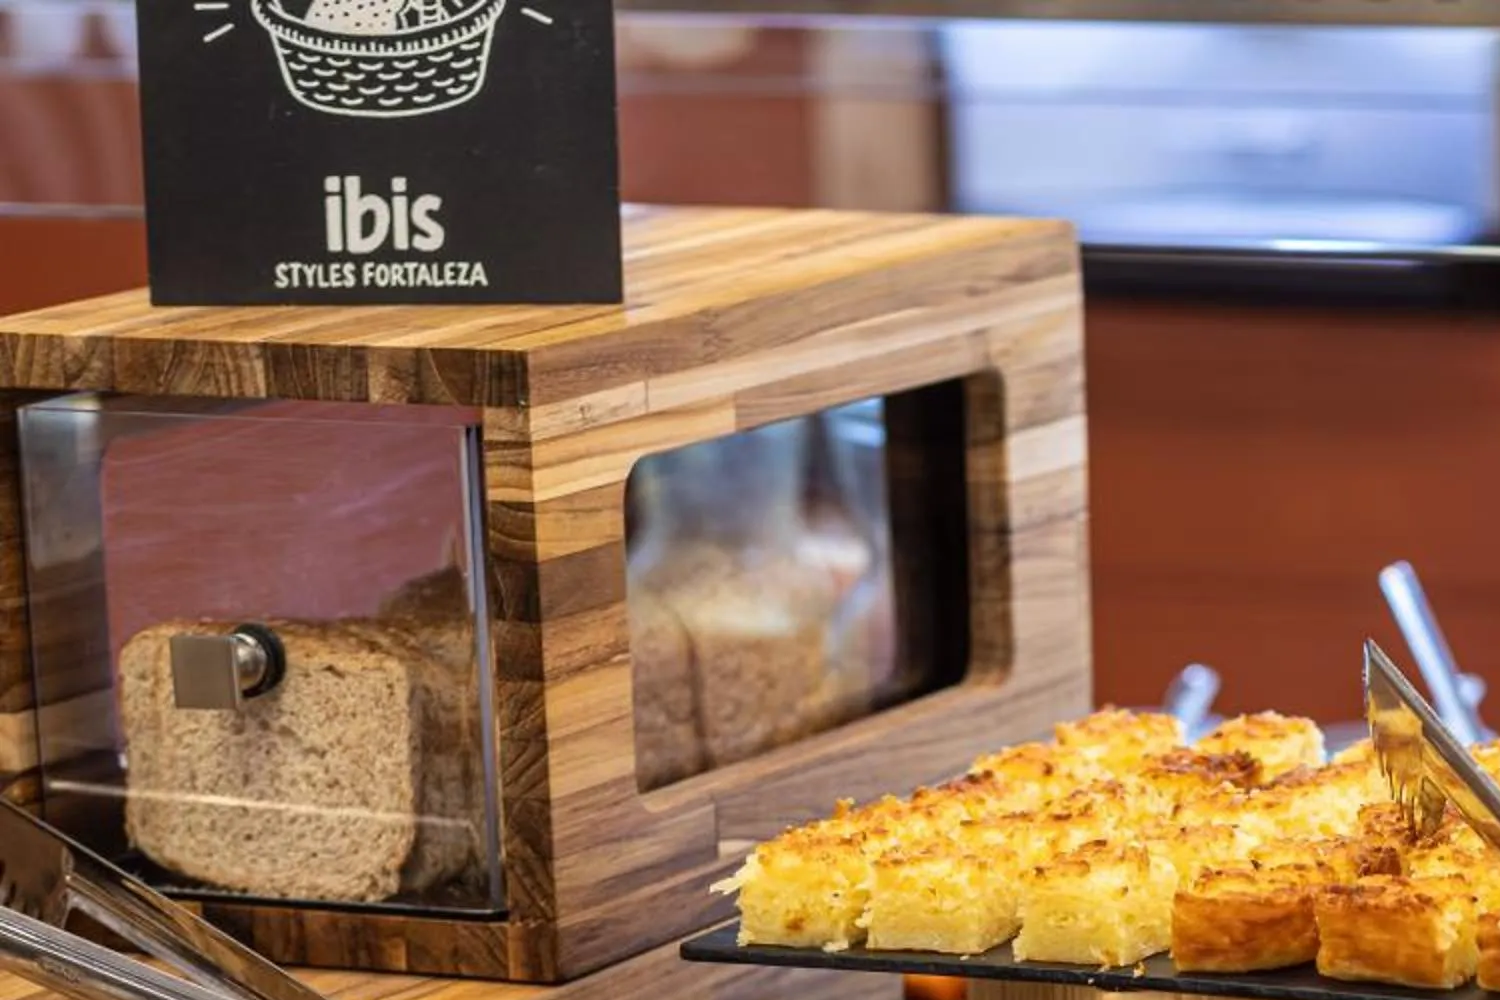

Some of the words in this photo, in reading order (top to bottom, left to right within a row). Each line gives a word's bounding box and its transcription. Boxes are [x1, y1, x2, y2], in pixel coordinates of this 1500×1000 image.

[323, 175, 446, 254] ibis
[274, 261, 356, 288] STYLES
[362, 261, 488, 287] FORTALEZA
